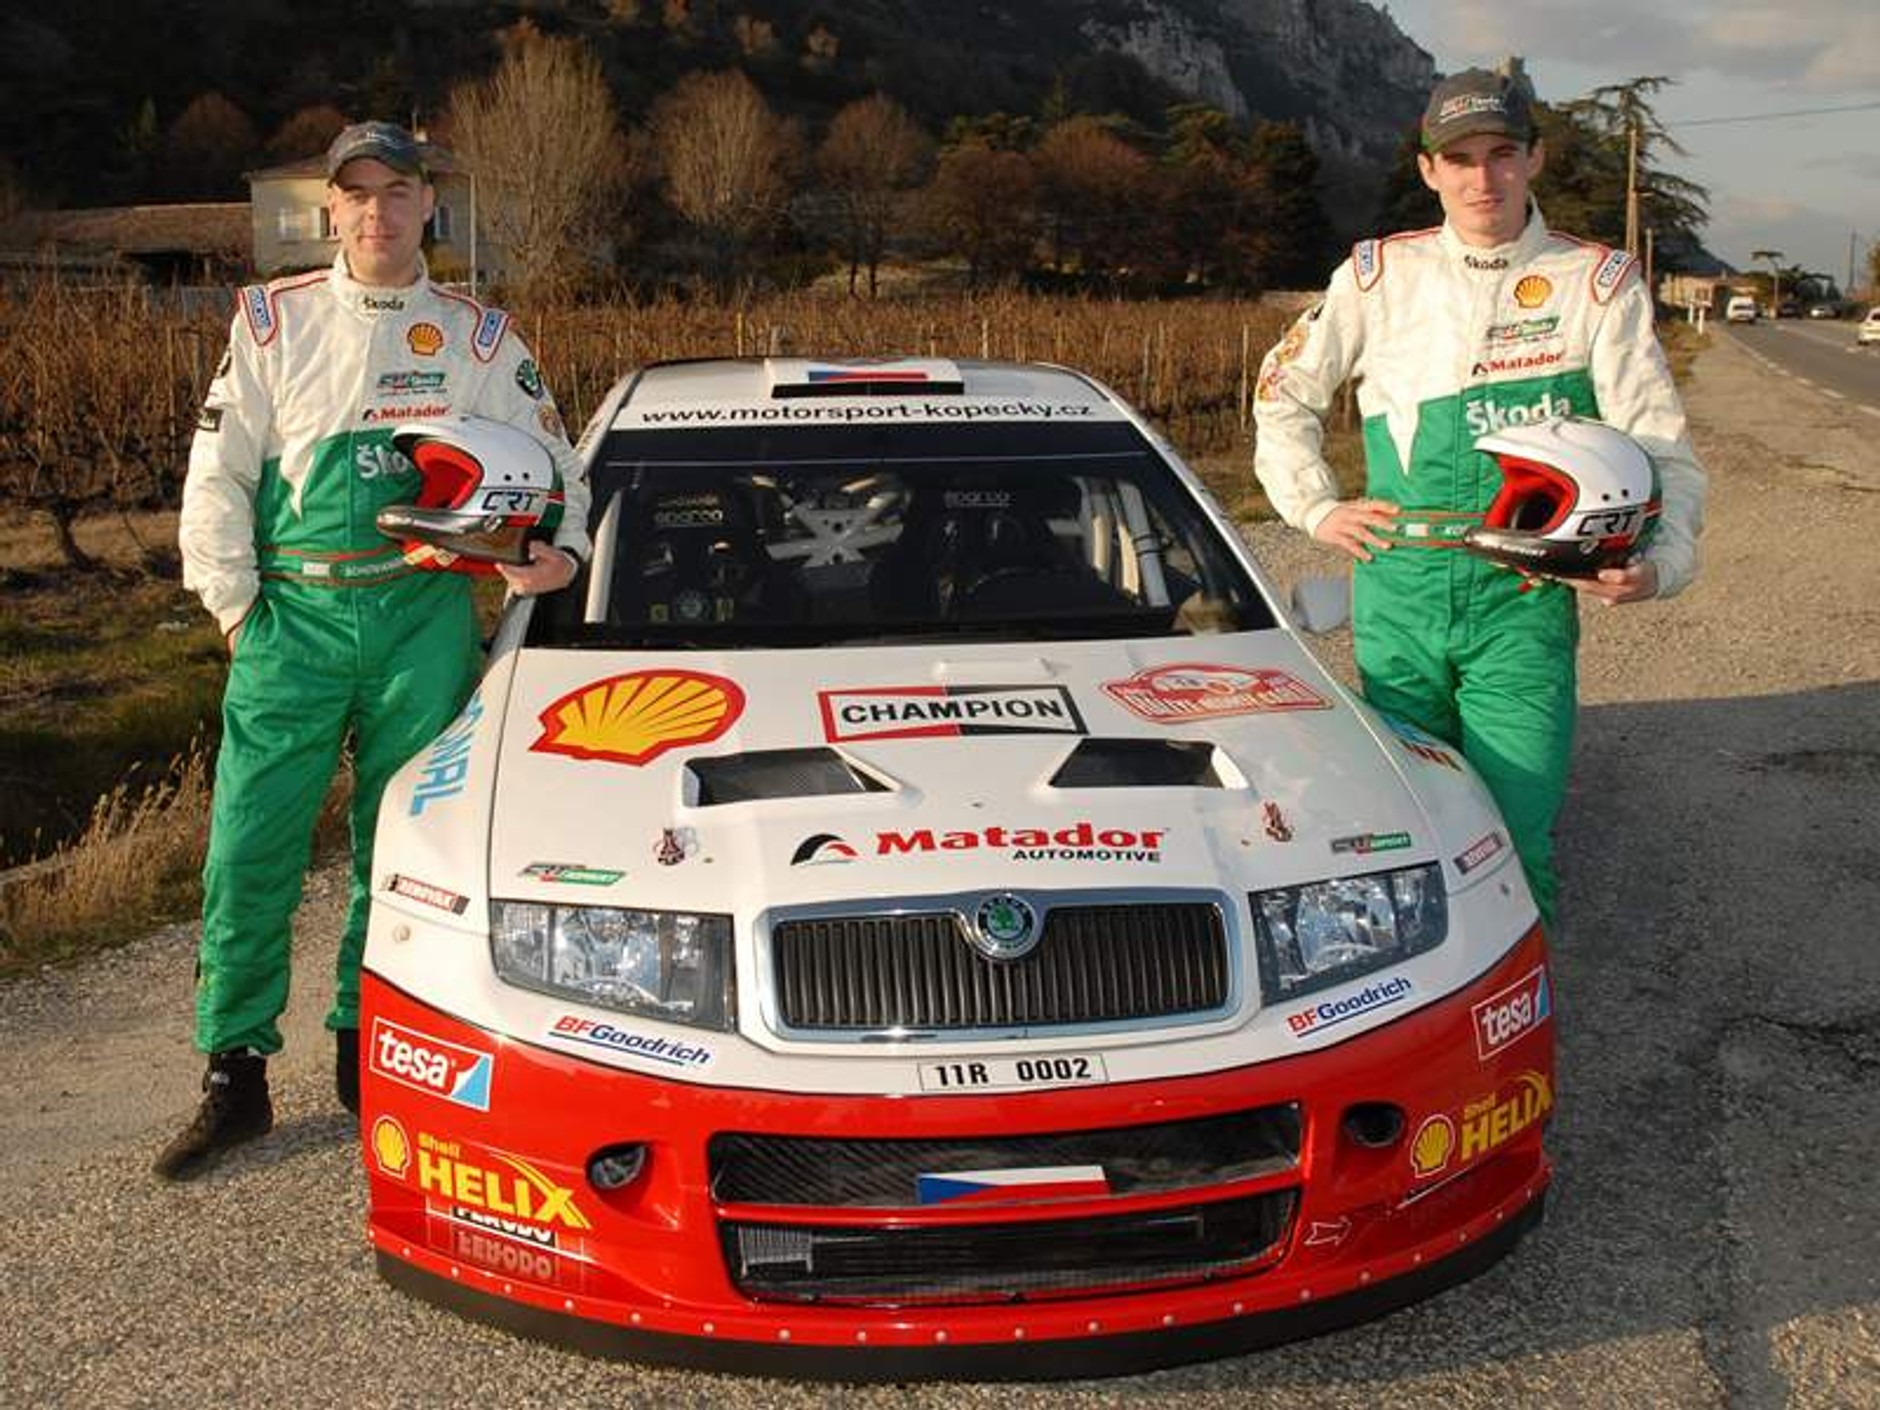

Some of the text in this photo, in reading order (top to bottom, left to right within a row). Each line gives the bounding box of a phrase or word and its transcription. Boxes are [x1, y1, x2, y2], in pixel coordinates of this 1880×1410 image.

[1489, 352, 1562, 372] Matador
[380, 404, 448, 420] Matador
[642, 400, 1092, 422] www.motorsport-kopecky.cz
[1467, 392, 1571, 436] Škoda
[356, 443, 409, 479] Ško
[481, 490, 540, 512] CRT
[1577, 510, 1638, 537] CRT
[841, 699, 1064, 725] CHAMPION
[875, 823, 1165, 855] Matador
[1012, 848, 1161, 863] AUTOMOTIVE
[1286, 977, 1412, 1032] BFGoodrich
[1481, 991, 1531, 1045] tesa
[554, 1014, 713, 1065] BFGoodrich
[378, 1029, 449, 1089] tesa
[934, 1057, 1091, 1087] 11R 0002
[417, 1149, 592, 1231] HELIX
